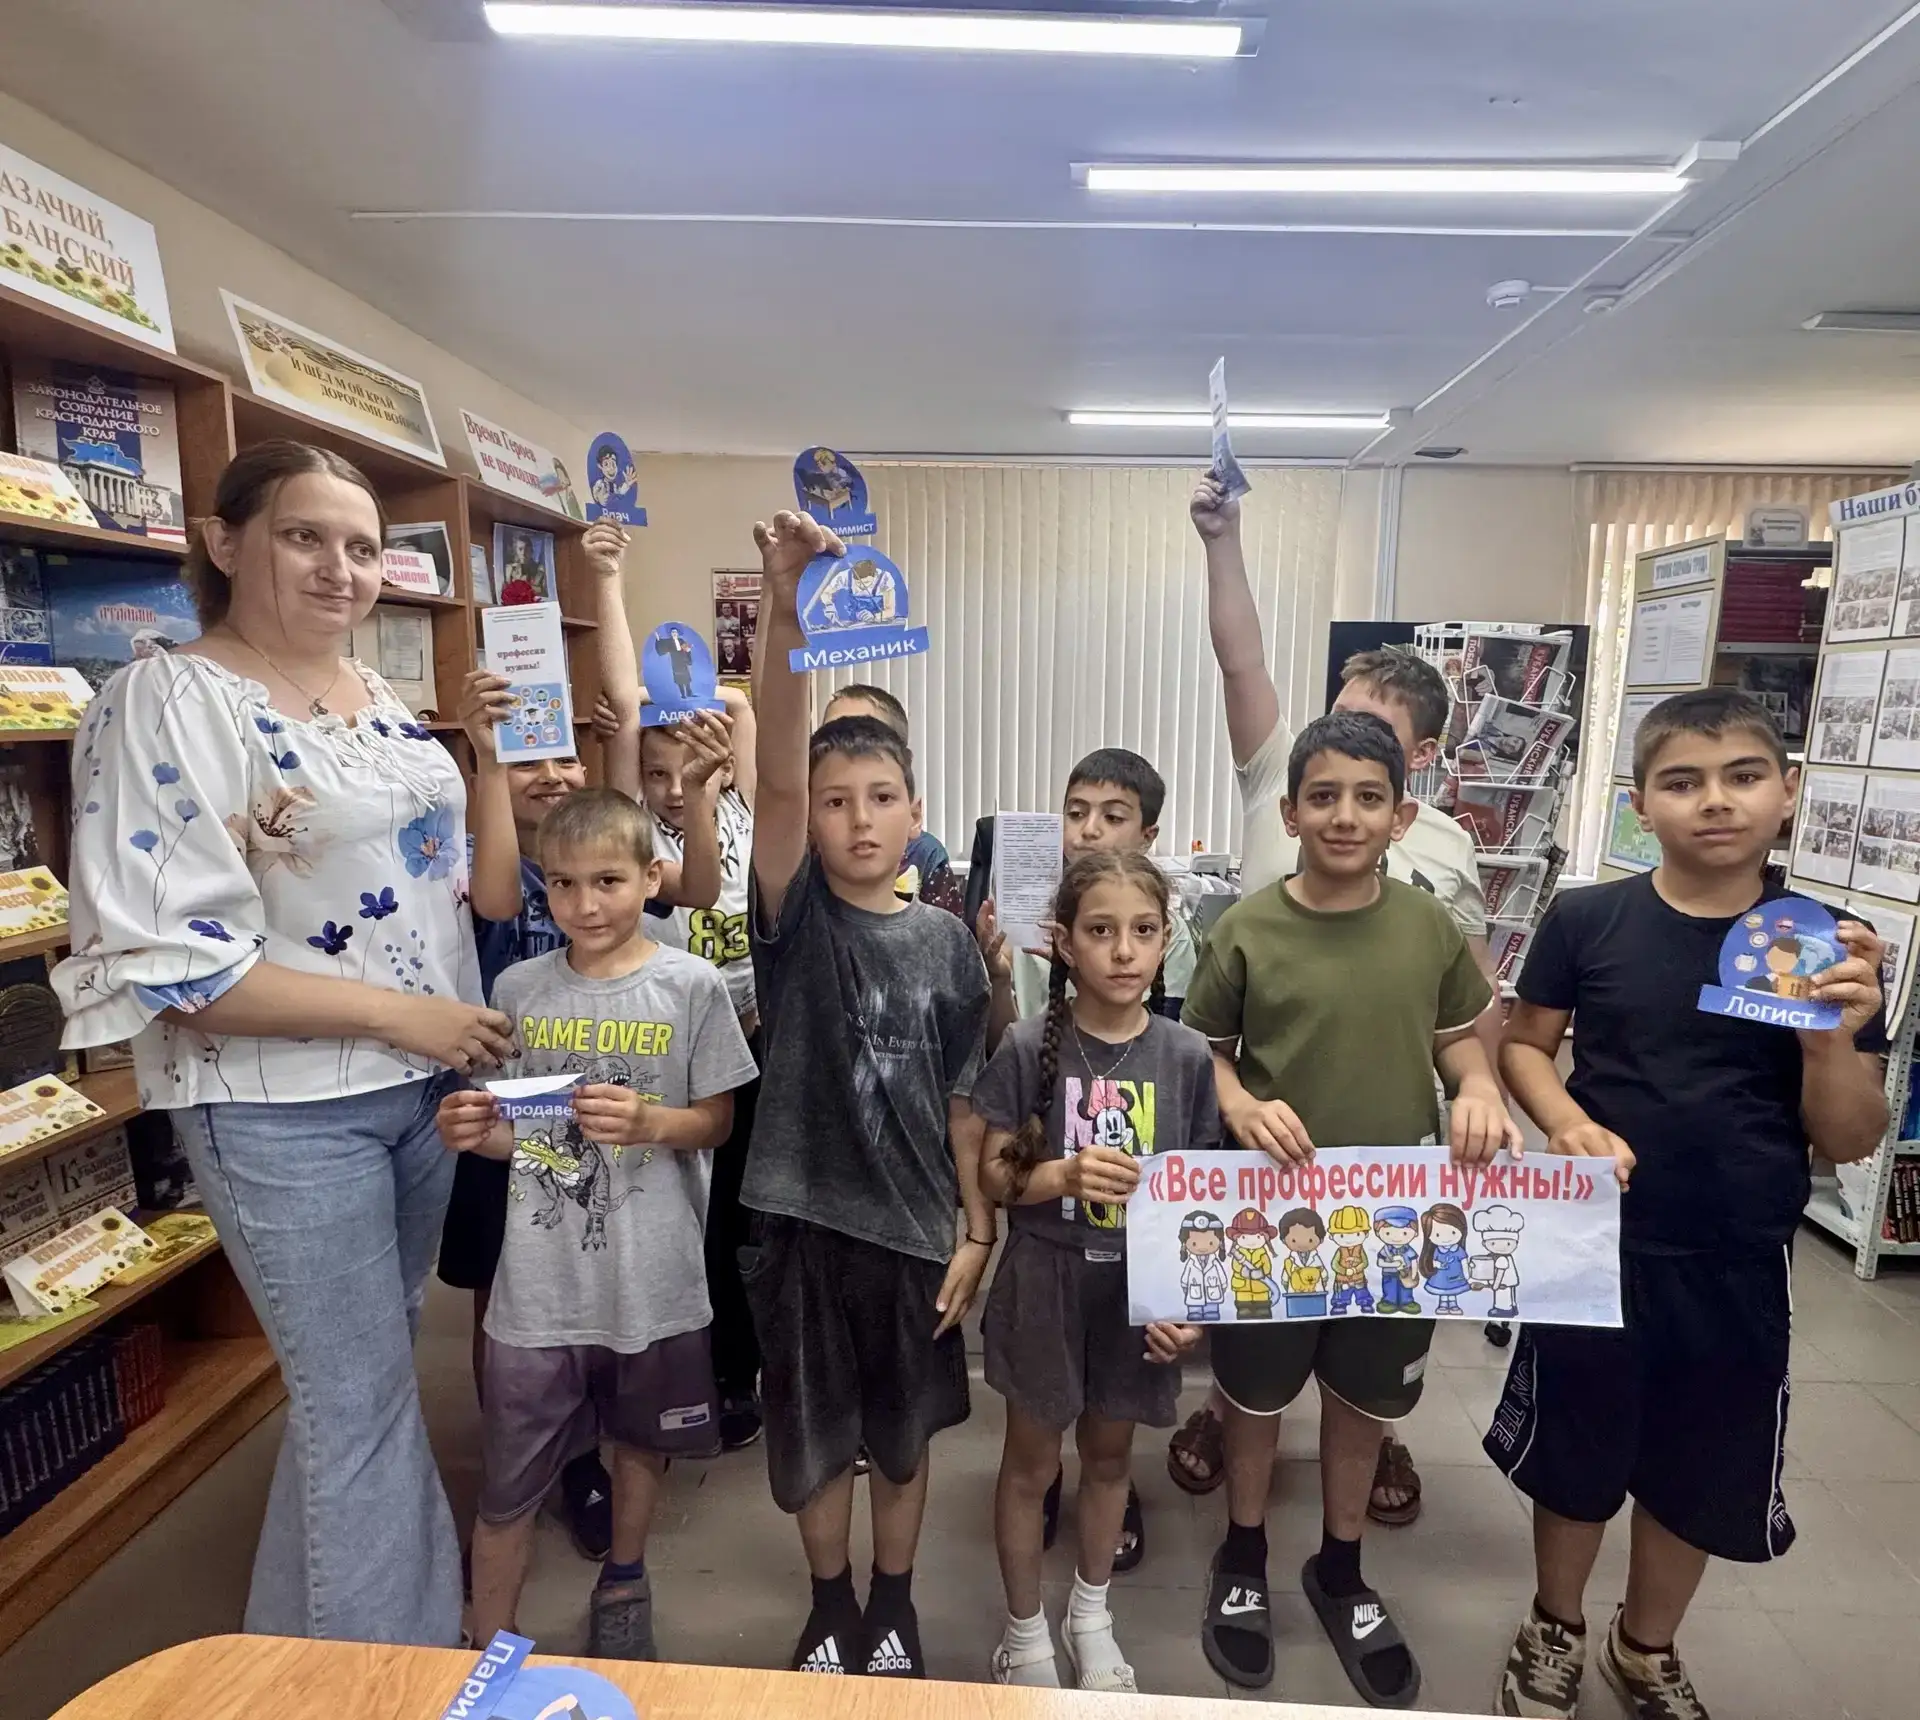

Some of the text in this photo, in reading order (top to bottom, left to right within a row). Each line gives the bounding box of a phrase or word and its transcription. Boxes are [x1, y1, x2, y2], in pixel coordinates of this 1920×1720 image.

[28, 383, 163, 415] ЗАКОНОДАТЕЛЬНОЕ
[59, 399, 134, 421] СОБРАНИЕ
[320, 384, 383, 418] ДОРОГАМИ
[35, 407, 160, 436] КРАСНОДАРСКОГО
[82, 427, 116, 441] КРАЯ
[480, 451, 496, 470] не
[1839, 481, 1920, 521] Наши б
[511, 634, 529, 643] Все
[803, 638, 918, 668] Механик
[1724, 995, 1817, 1027] Логист
[523, 1016, 674, 1056] GAME OVER
[499, 1102, 576, 1119] Продаве
[1149, 1155, 1595, 1210] «Все профессии нужны!»
[1354, 1603, 1381, 1625] NIKE
[800, 1661, 845, 1676] adidas
[867, 1655, 913, 1673] adidas
